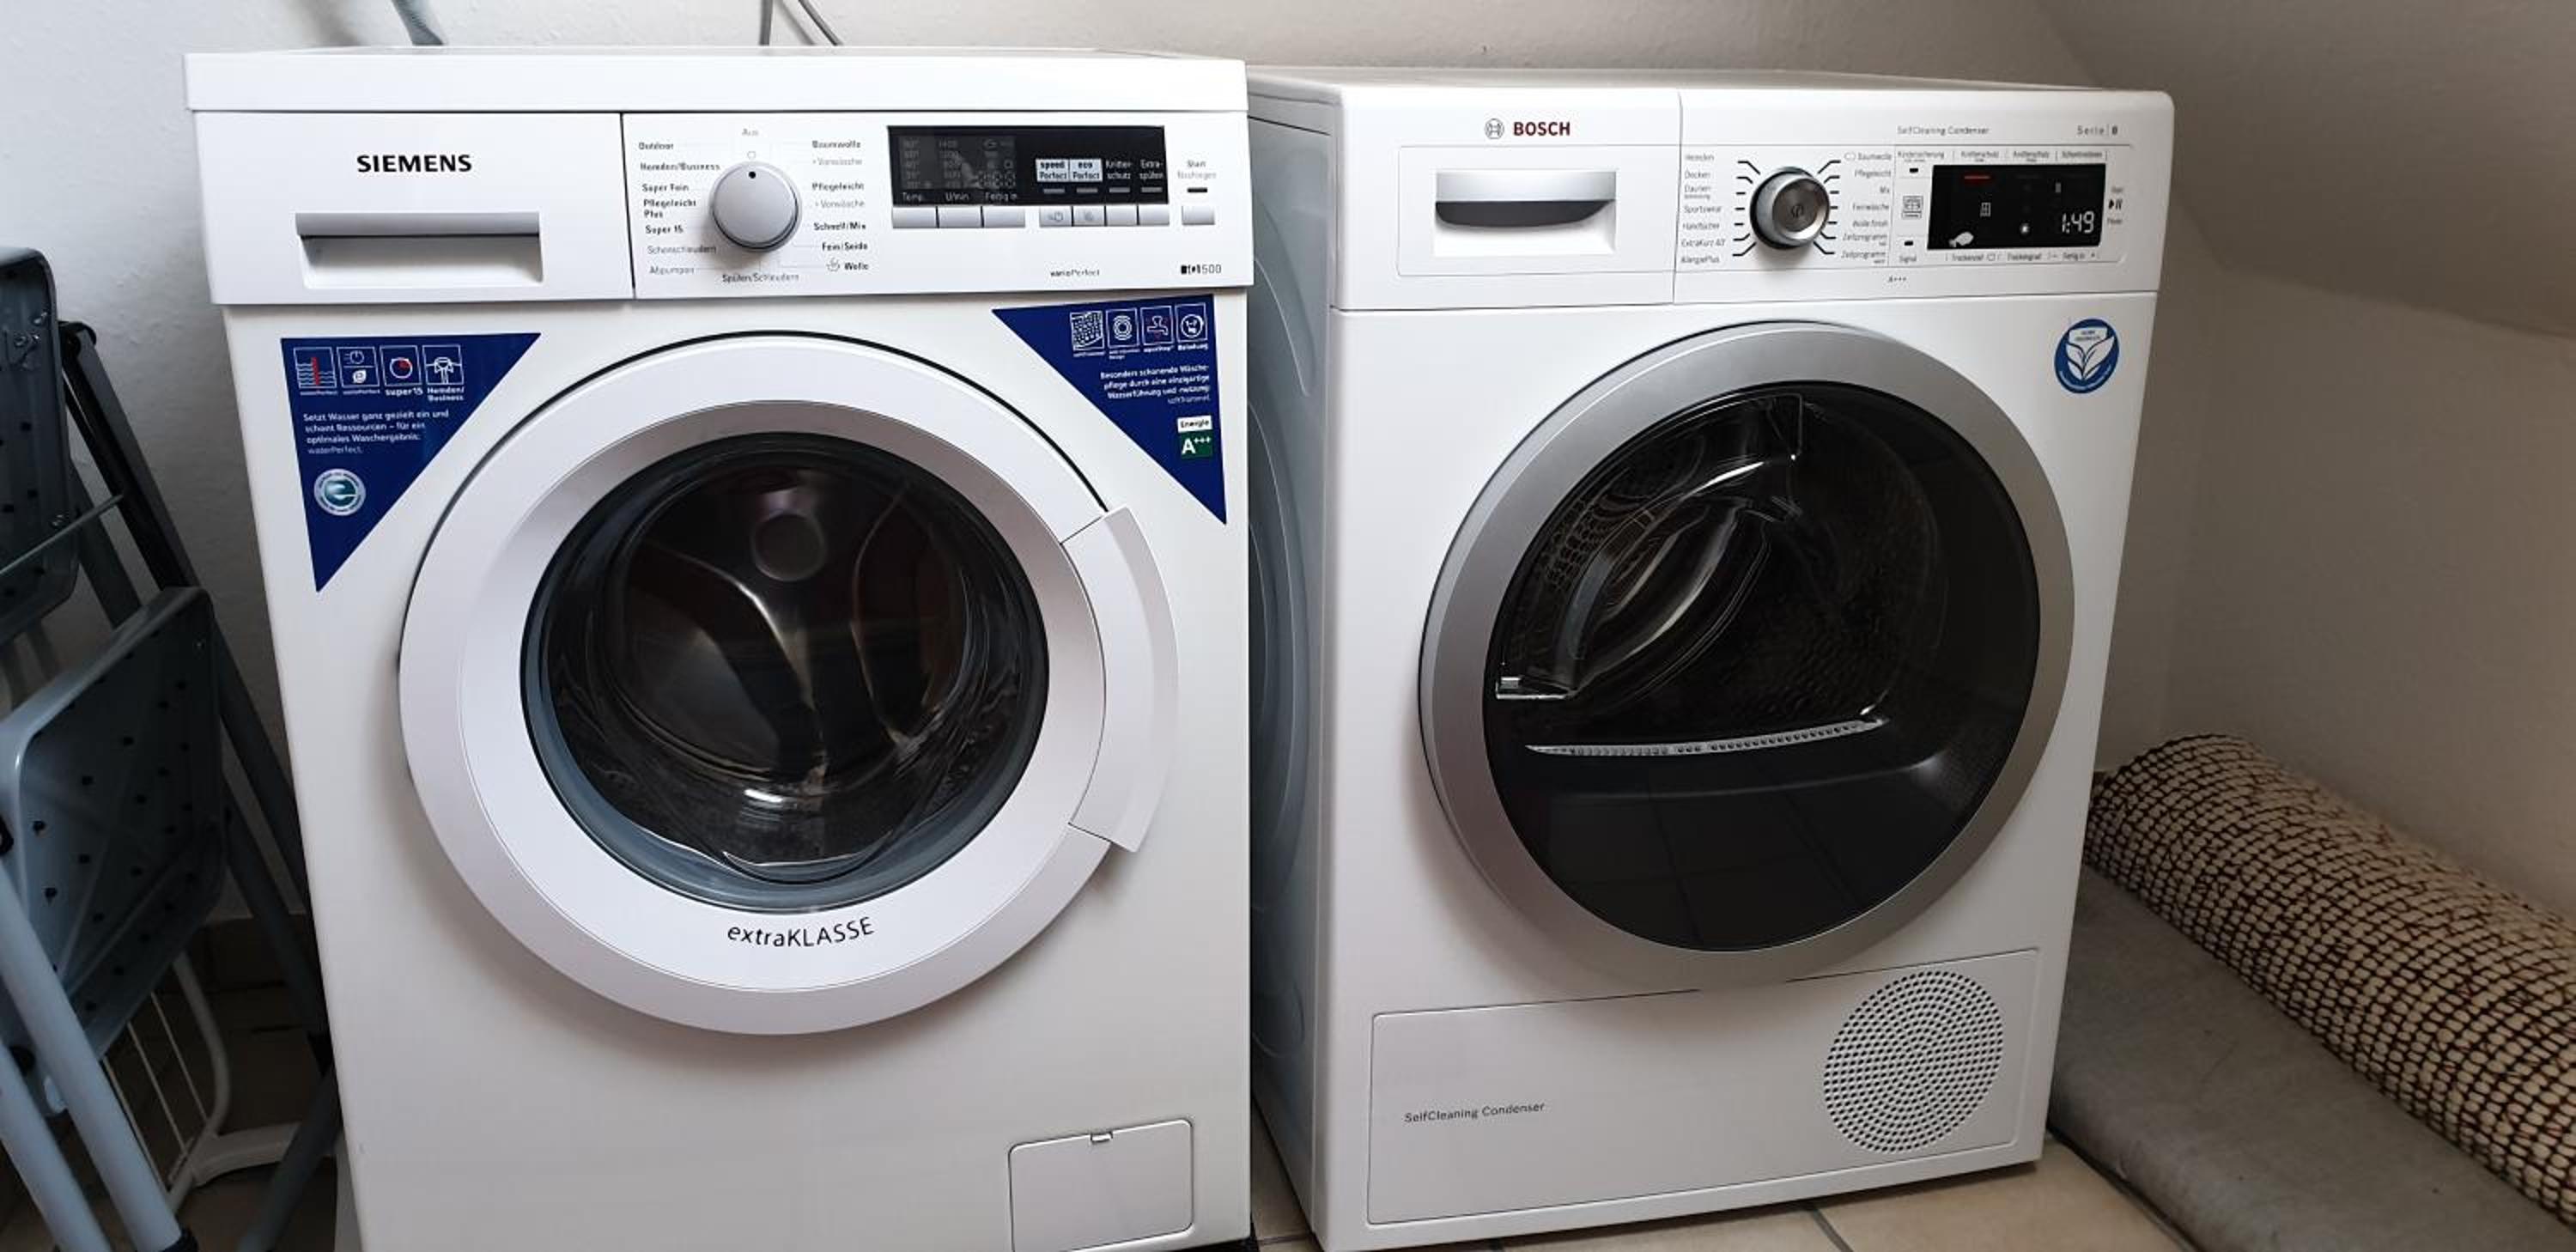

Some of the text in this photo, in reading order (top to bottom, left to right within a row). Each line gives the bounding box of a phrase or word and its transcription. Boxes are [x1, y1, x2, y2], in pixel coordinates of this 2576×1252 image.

[1513, 121, 1571, 137] BOSCH
[1897, 125, 1990, 137] SelfCleaning Condenser
[2077, 125, 2105, 135] Serie
[638, 142, 674, 150] Outdoor
[811, 139, 861, 149] Baumwolle
[356, 153, 473, 173] SIEMENS
[640, 161, 721, 171] Hemden/Business
[1040, 160, 1066, 170] speed
[1077, 161, 1093, 169] eco
[1139, 158, 1163, 168] Extra-
[1040, 171, 1067, 179] Perfect
[1072, 171, 1101, 179] Perfect
[641, 183, 668, 193] Super
[811, 181, 865, 192] Pflegeleicht
[643, 198, 697, 209] Pflegeleicht
[643, 209, 664, 218] Plus
[813, 222, 866, 231] Schnell/Mix
[2062, 210, 2095, 234] 1:49
[645, 224, 684, 235] Super 15
[822, 241, 868, 251] Fein/Seide
[843, 261, 869, 270] Wolle
[1100, 370, 1138, 380] Besonders
[1139, 366, 1179, 376] schonende
[1103, 380, 1127, 391] pflege
[1129, 379, 1150, 387] durch
[1108, 388, 1162, 400] Wasserführung
[1163, 386, 1176, 395] und
[303, 412, 327, 422] Setzt
[328, 411, 361, 422] Wasser
[361, 413, 383, 422] ganz
[386, 410, 415, 422] gezielt
[432, 409, 449, 418] und
[305, 423, 335, 433] schont
[336, 422, 387, 432] Ressourcen
[396, 421, 410, 430] für
[1180, 418, 1210, 428] Energie
[306, 434, 349, 444] optimales
[727, 915, 875, 947] extraKLASSE
[1404, 1102, 1546, 1123] SelfCleaning Condenser
